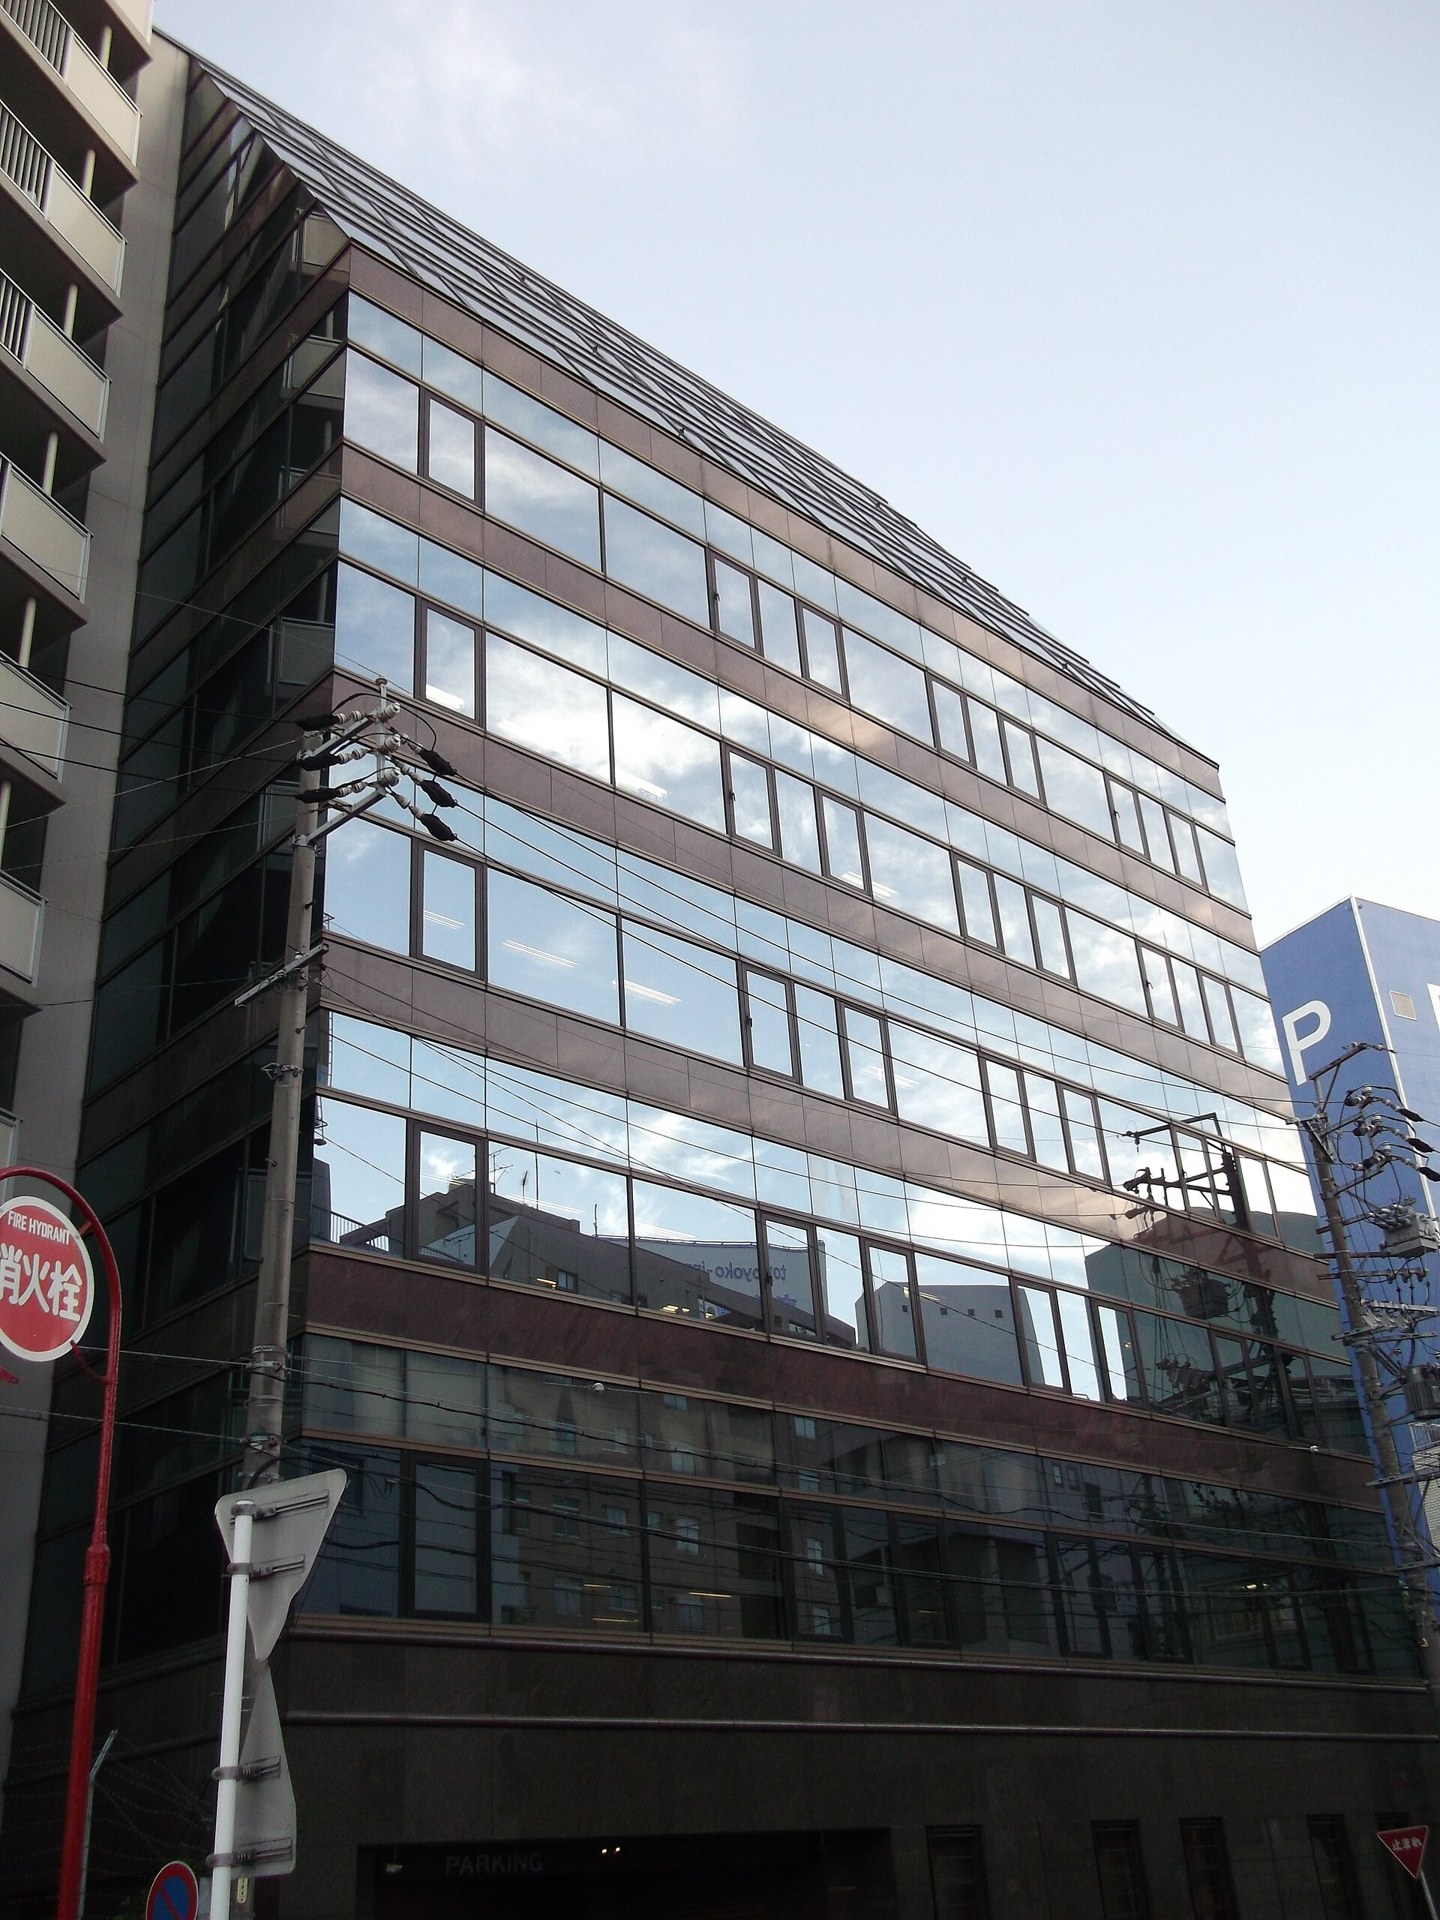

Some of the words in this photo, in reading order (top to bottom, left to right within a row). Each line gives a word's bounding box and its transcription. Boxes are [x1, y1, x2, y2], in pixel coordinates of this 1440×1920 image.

[1282, 1000, 1332, 1086] P
[7, 1210, 28, 1231] FIRE
[28, 1217, 71, 1246] HYDRANT
[0, 1243, 83, 1322] 消火栓
[1391, 1836, 1422, 1851] 止まれ
[446, 1851, 544, 1875] PARKING
